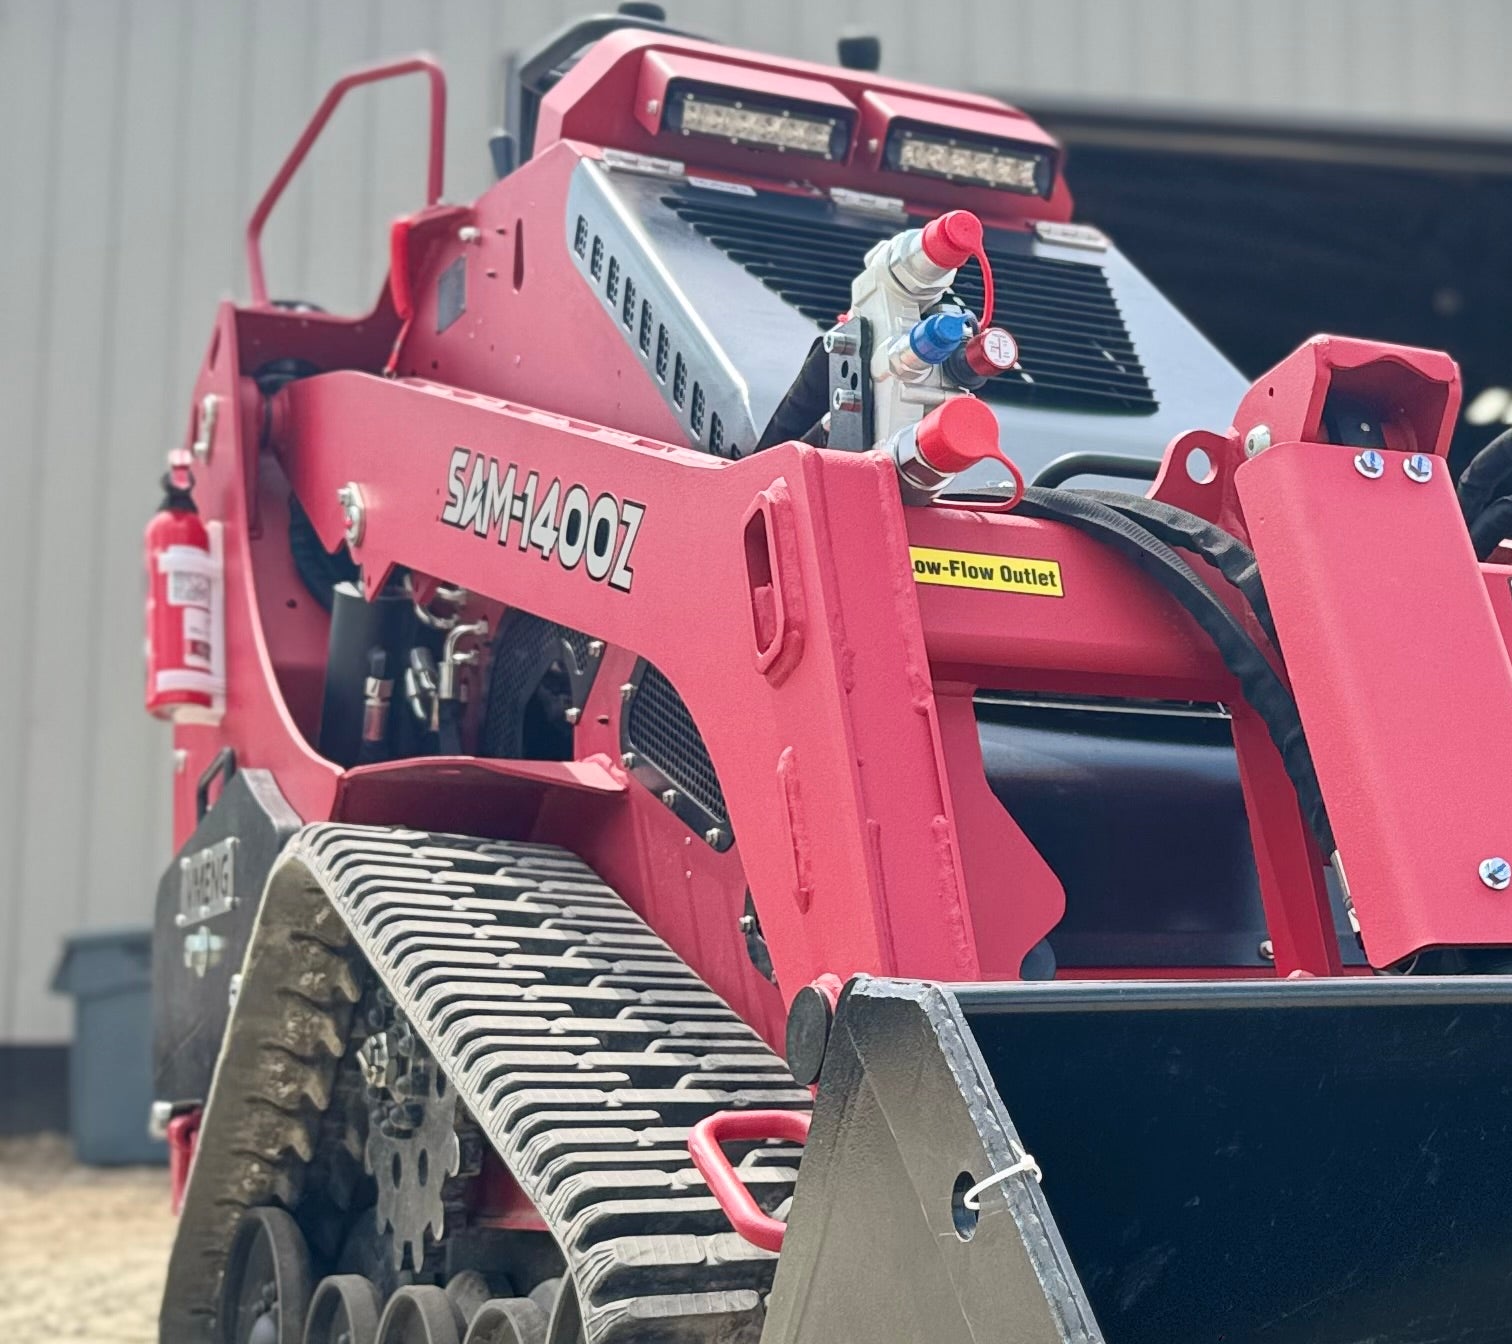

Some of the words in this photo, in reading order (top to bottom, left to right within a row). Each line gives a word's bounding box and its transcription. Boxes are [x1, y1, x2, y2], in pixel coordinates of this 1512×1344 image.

[441, 446, 646, 593] SAM-1400Z
[912, 559, 994, 580] ow-Flow
[1000, 565, 1057, 587] Outlet
